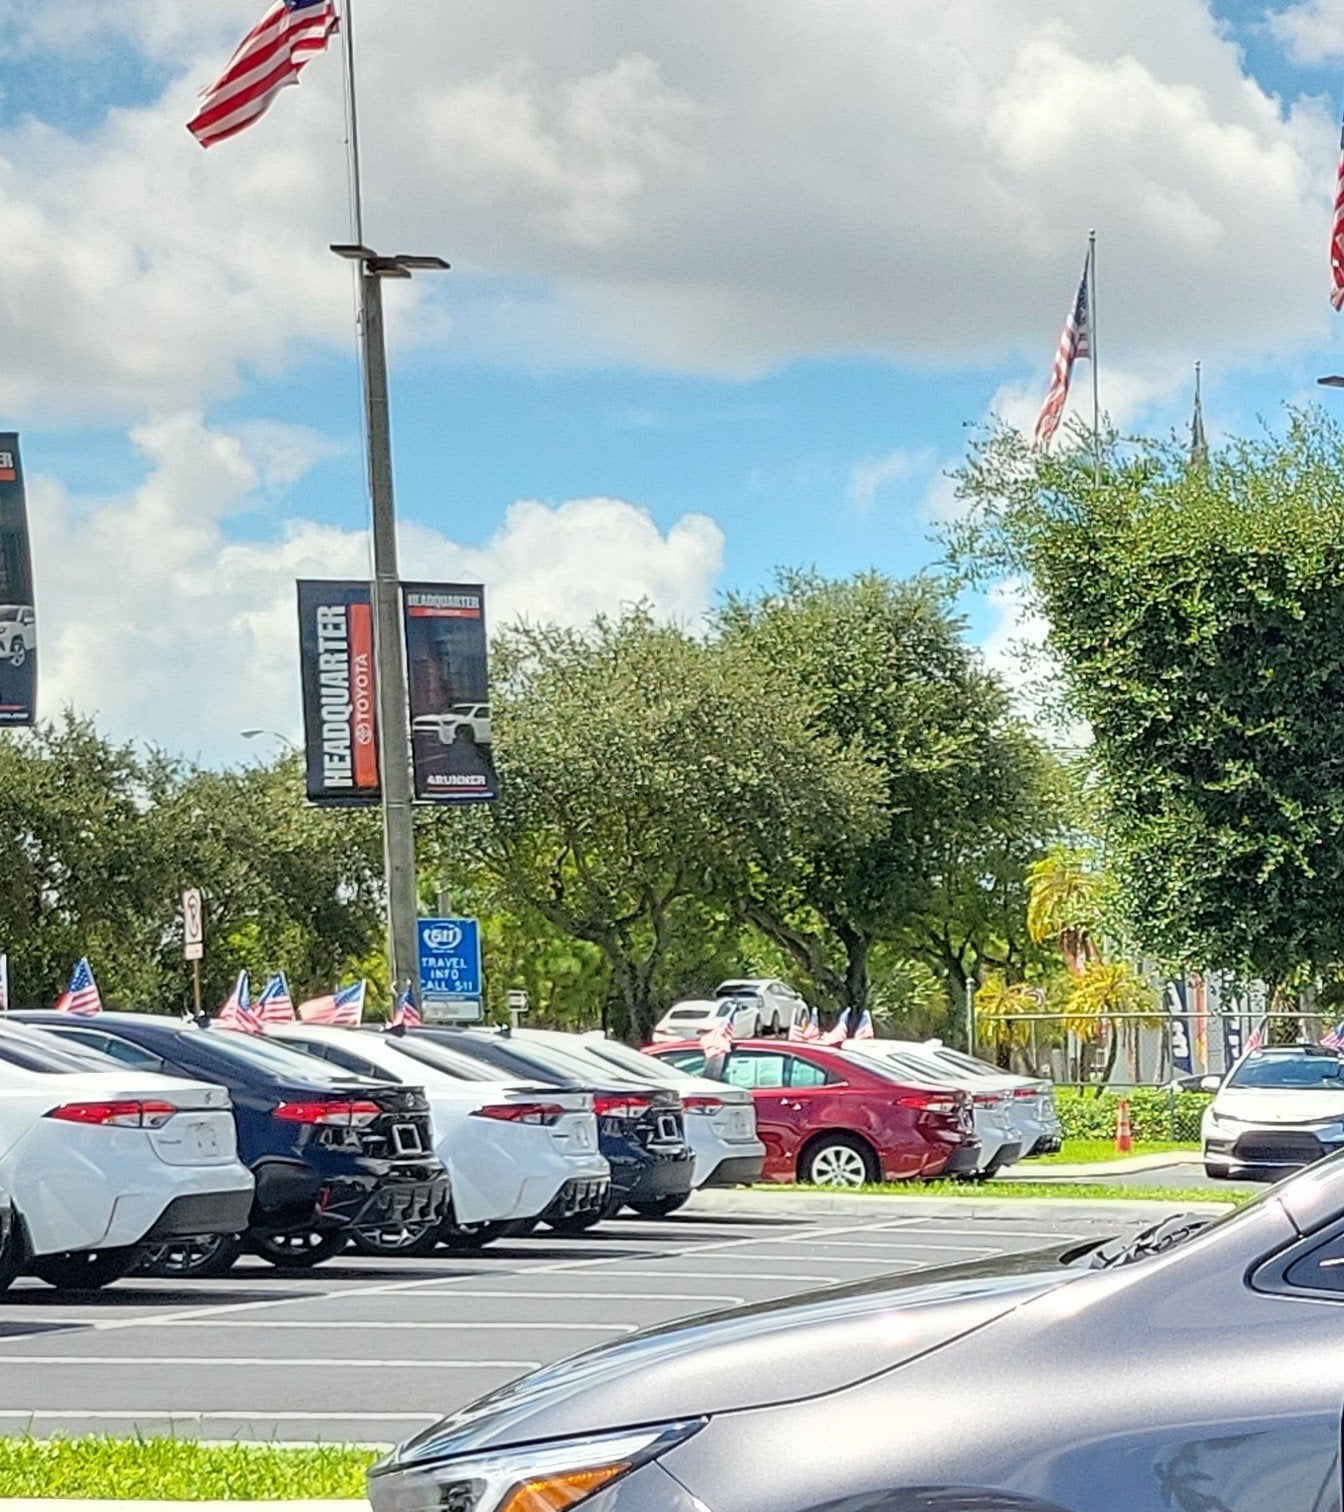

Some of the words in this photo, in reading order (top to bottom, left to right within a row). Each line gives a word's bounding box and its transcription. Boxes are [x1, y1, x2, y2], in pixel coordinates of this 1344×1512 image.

[354, 653, 370, 721] TOYOTA
[317, 606, 353, 787] HEADQUARTER
[421, 957, 468, 969] TRAVEL
[430, 969, 459, 980] INFO
[454, 980, 473, 991] 511
